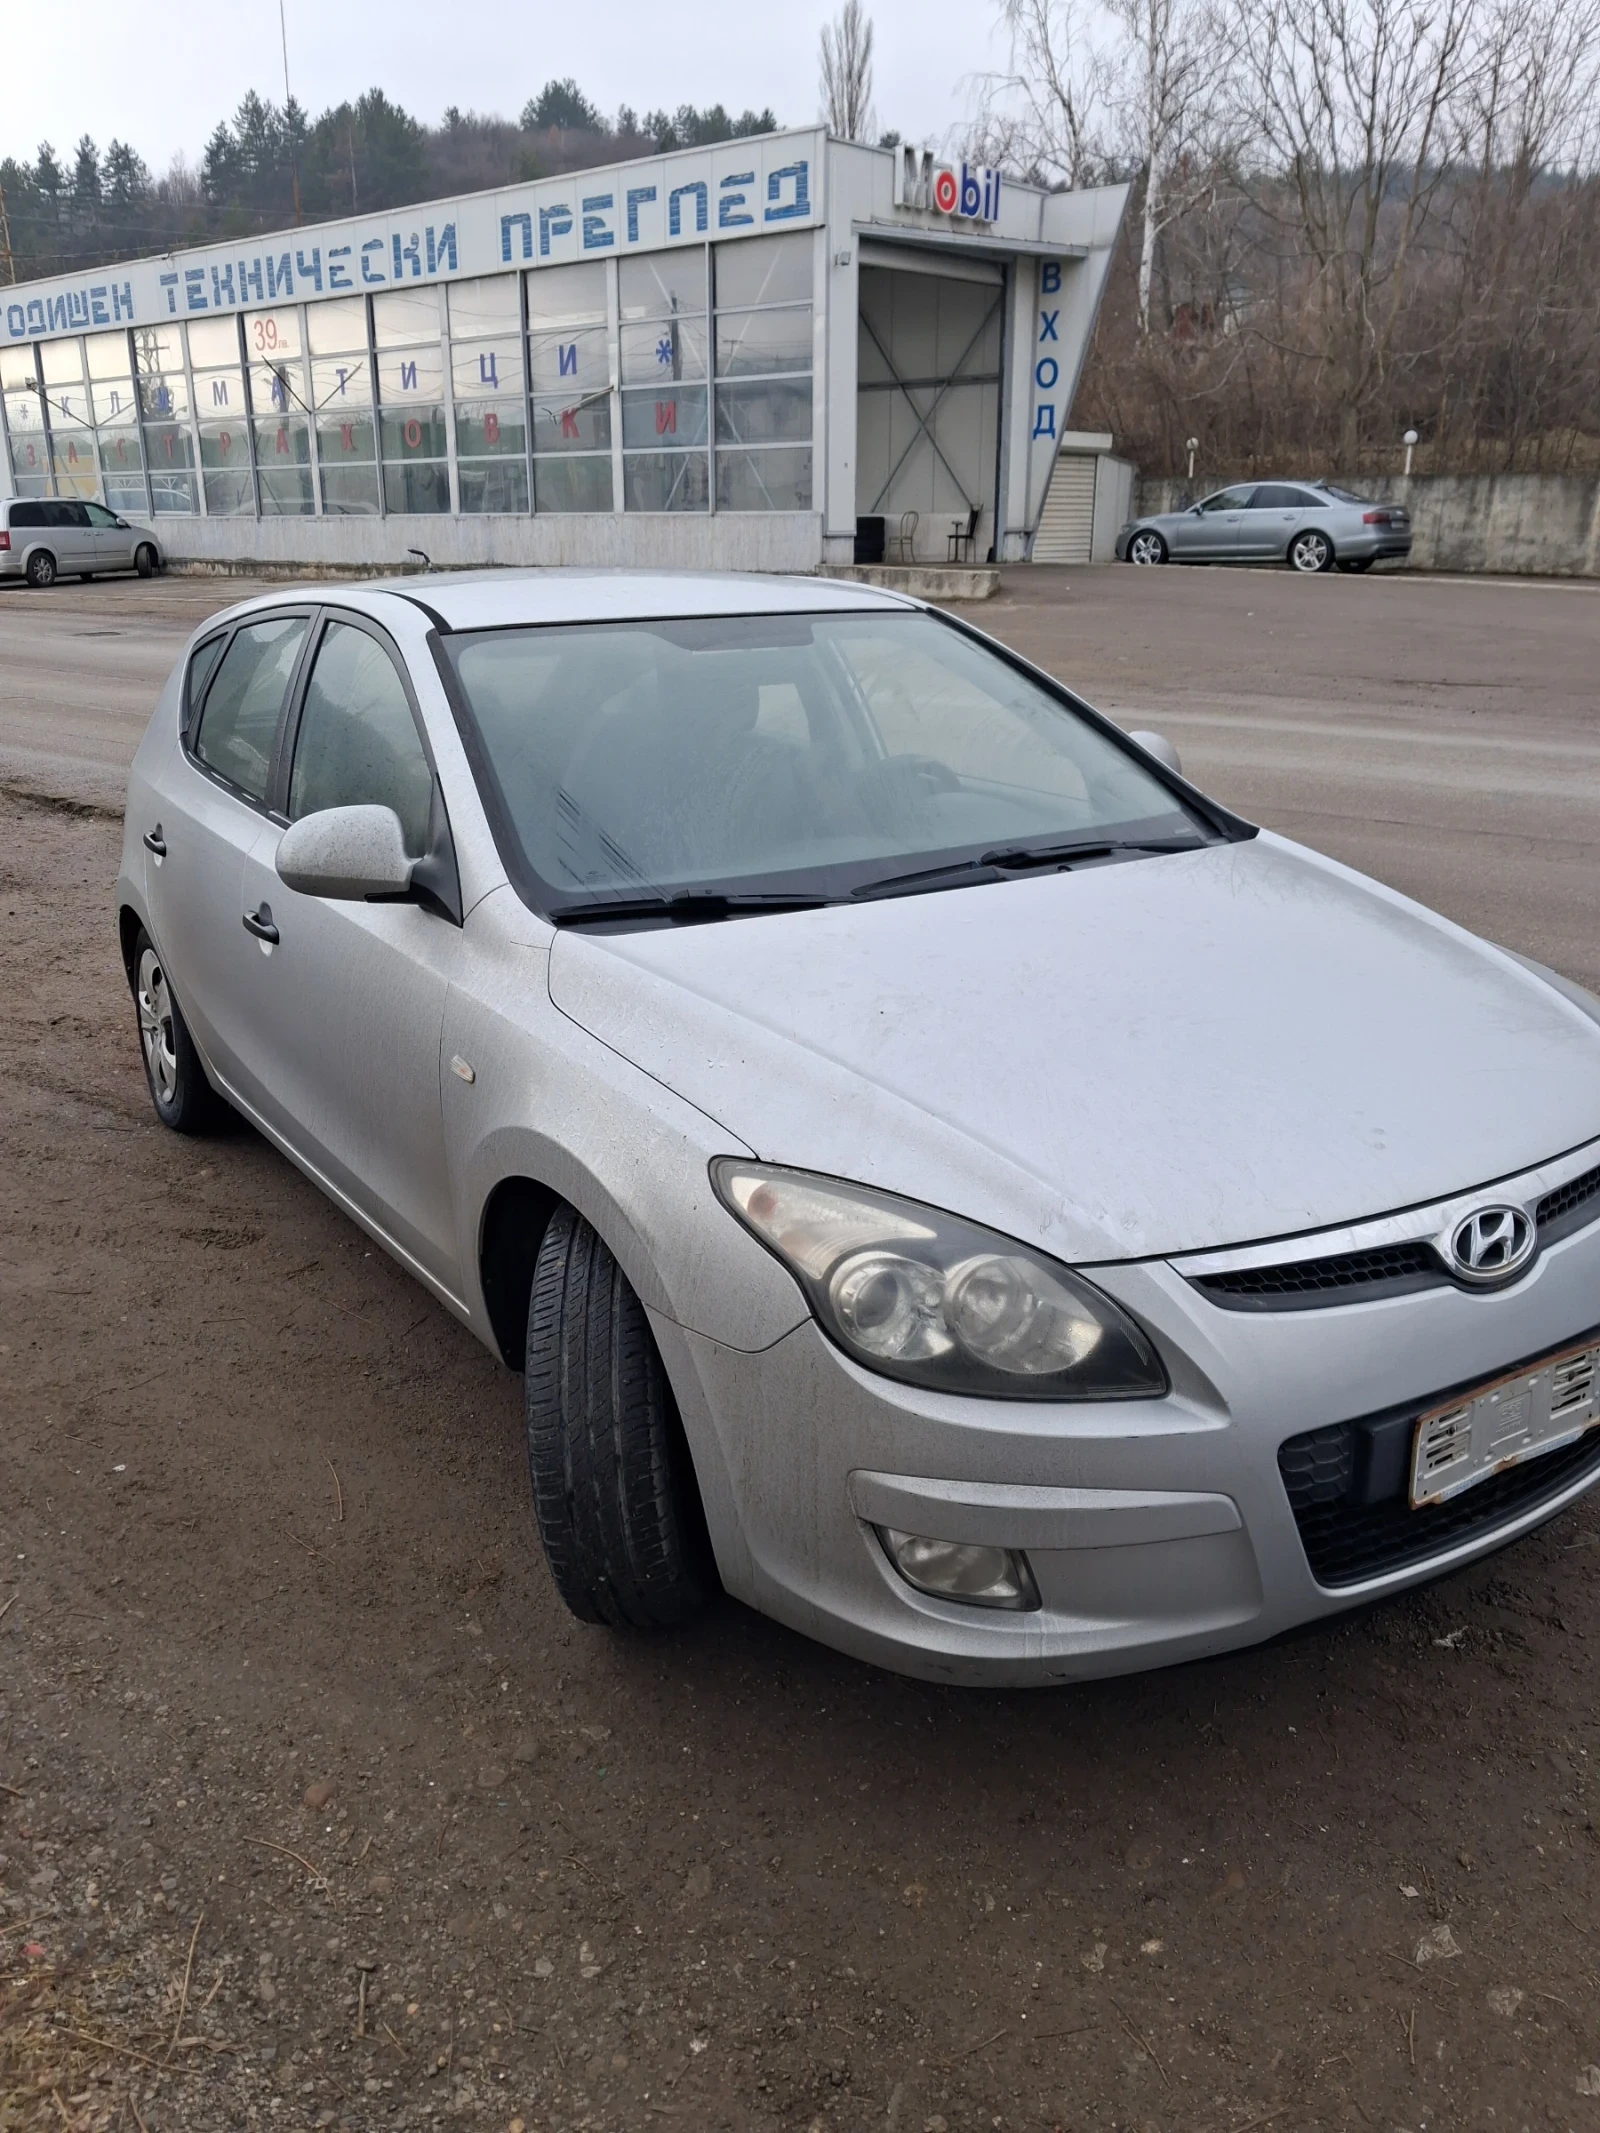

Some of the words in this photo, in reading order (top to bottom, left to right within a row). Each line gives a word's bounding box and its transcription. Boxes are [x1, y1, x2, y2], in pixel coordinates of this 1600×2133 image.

[893, 144, 1000, 222] Mobil
[0, 281, 134, 337] ОДИШЕН
[159, 222, 458, 313] ТЕХНИЧЕСКИ
[253, 318, 277, 351] 39
[1033, 262, 1062, 440] ВХОД
